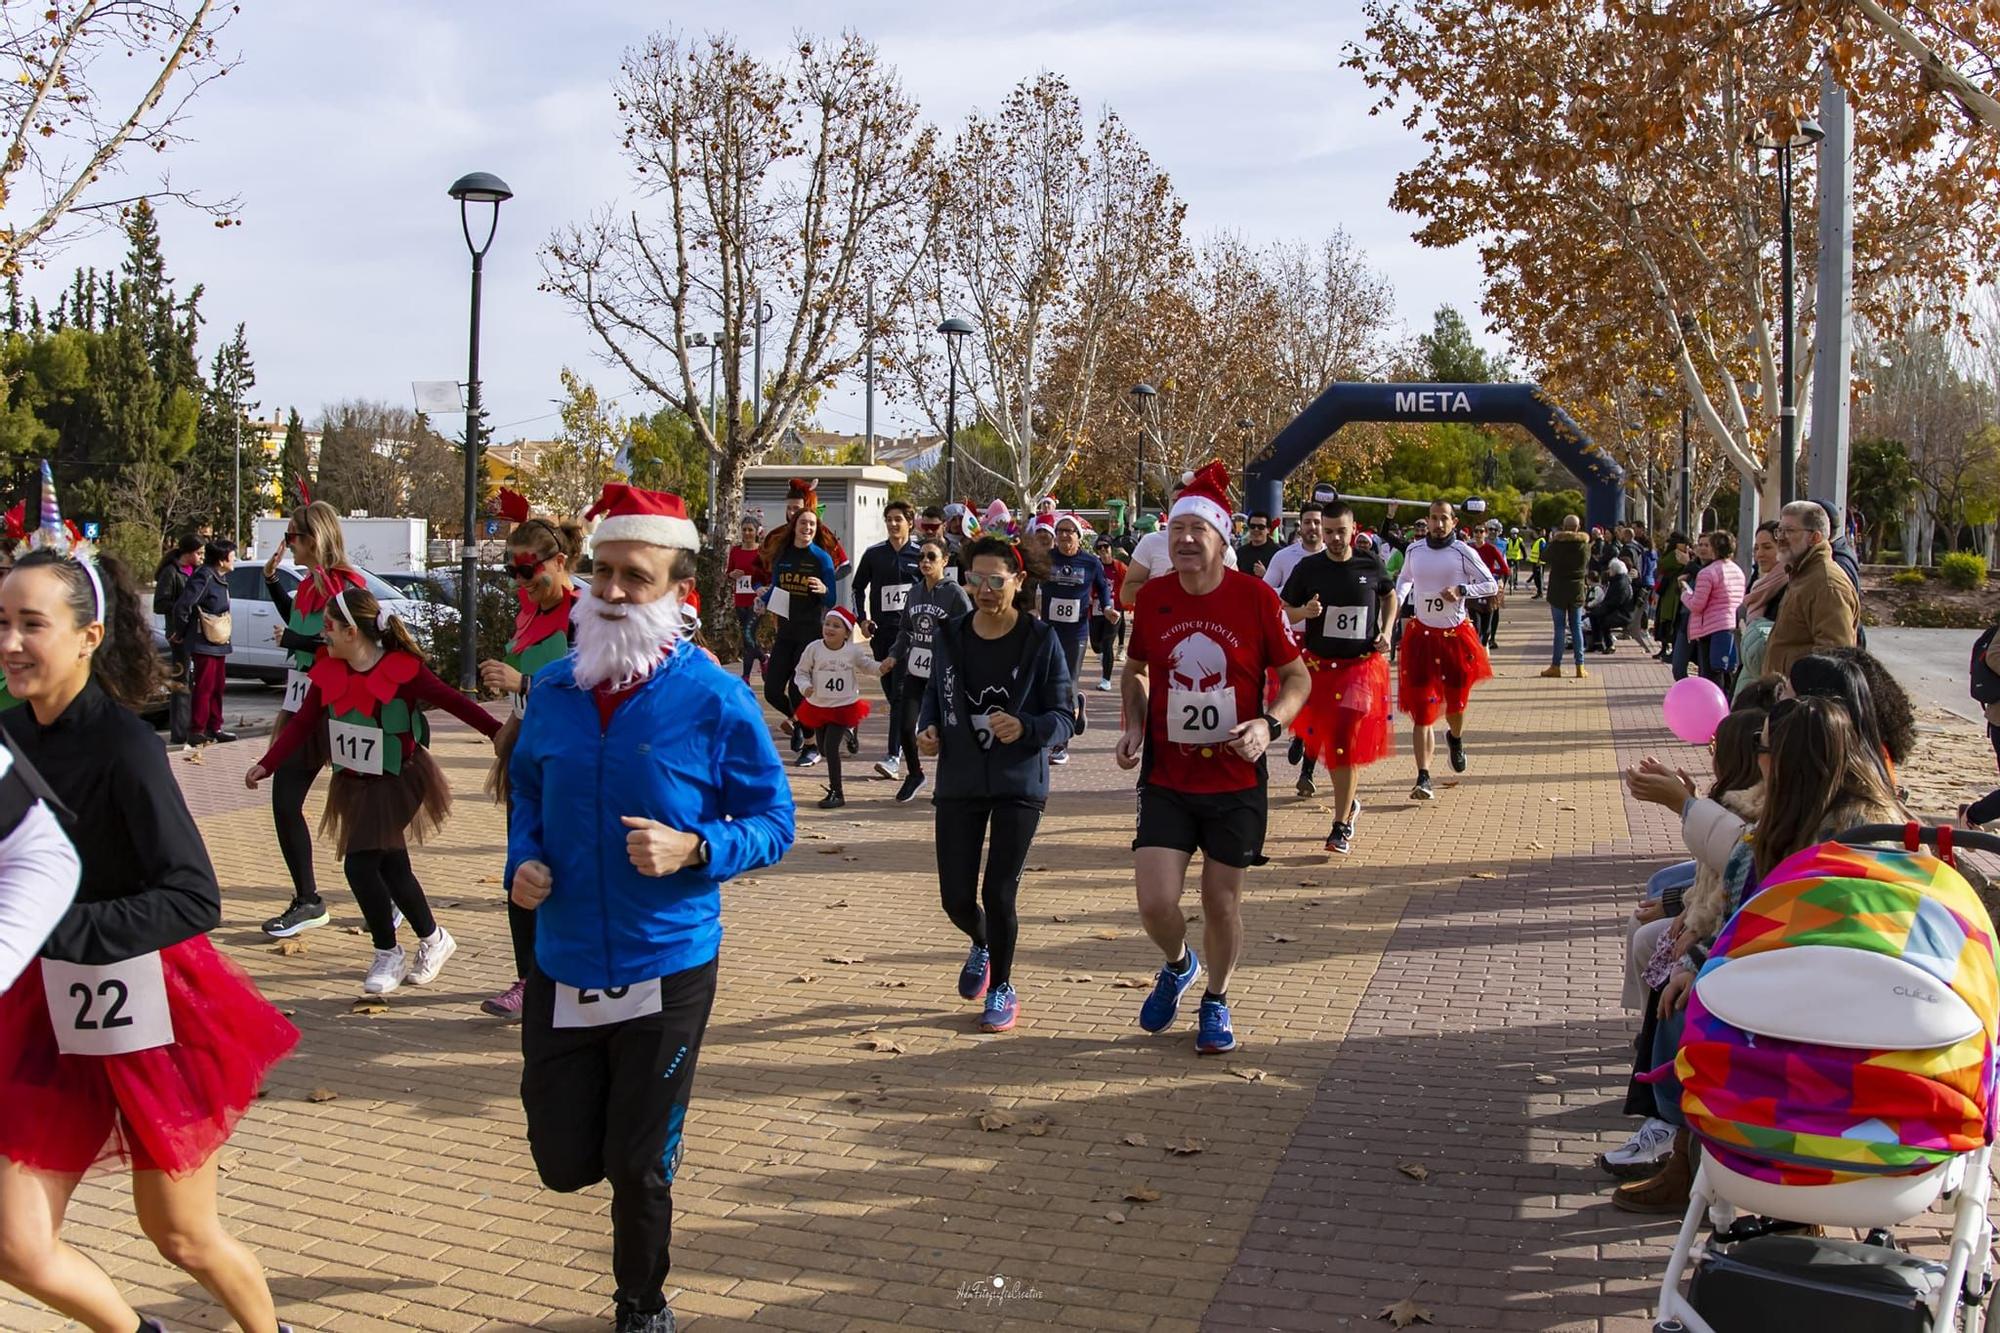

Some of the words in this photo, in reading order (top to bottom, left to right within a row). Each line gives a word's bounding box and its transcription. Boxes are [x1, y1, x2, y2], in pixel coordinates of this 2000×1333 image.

[1395, 391, 1472, 413] META
[1056, 604, 1073, 617] 88
[1425, 598, 1444, 613] 79
[1337, 613, 1359, 632] 81
[914, 655, 931, 671] 44
[825, 678, 845, 692] 40
[1182, 704, 1219, 731] 20
[336, 733, 375, 761] 117
[69, 978, 134, 1030] 22
[663, 1045, 688, 1079] KIPSTA
